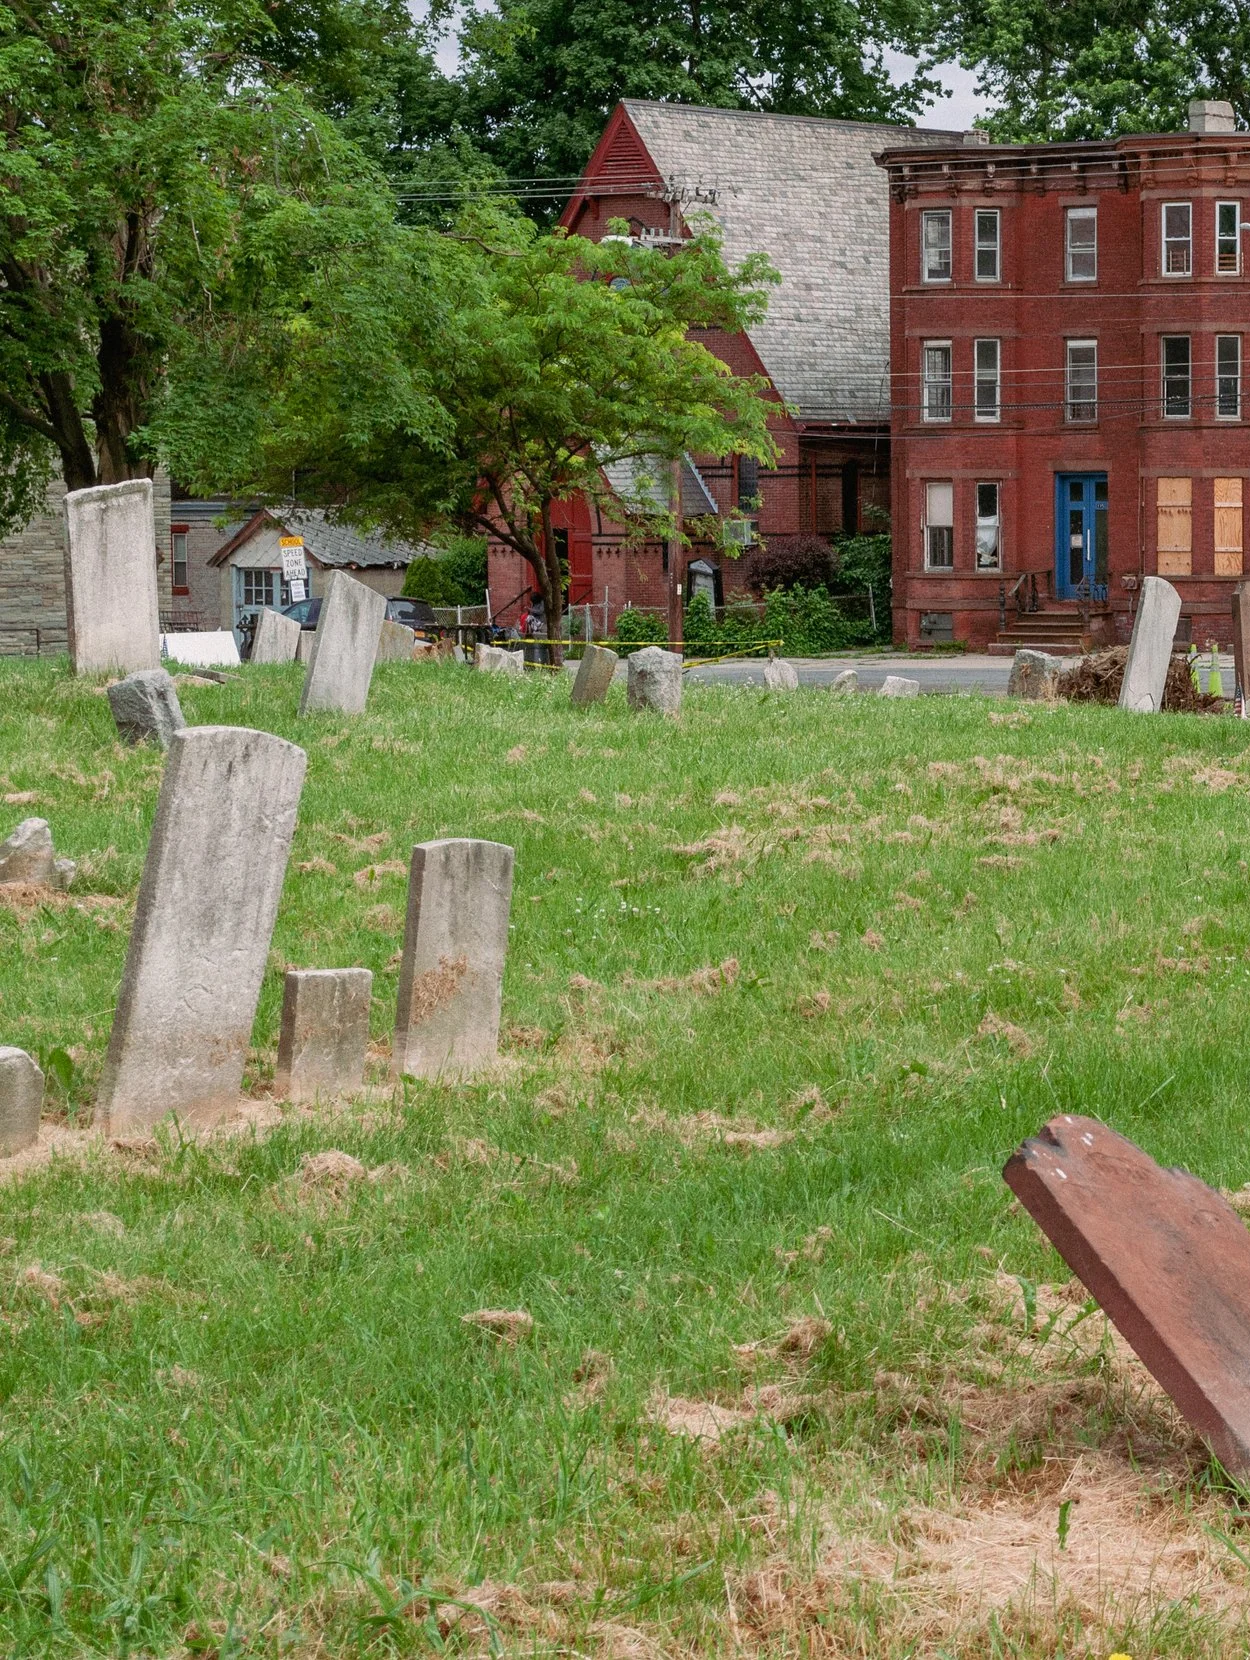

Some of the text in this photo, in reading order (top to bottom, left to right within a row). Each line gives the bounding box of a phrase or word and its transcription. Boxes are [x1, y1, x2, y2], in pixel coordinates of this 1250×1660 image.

[283, 548, 303, 557] SPEED
[285, 558, 303, 567] ZONE
[285, 569, 306, 577] AHEAD
